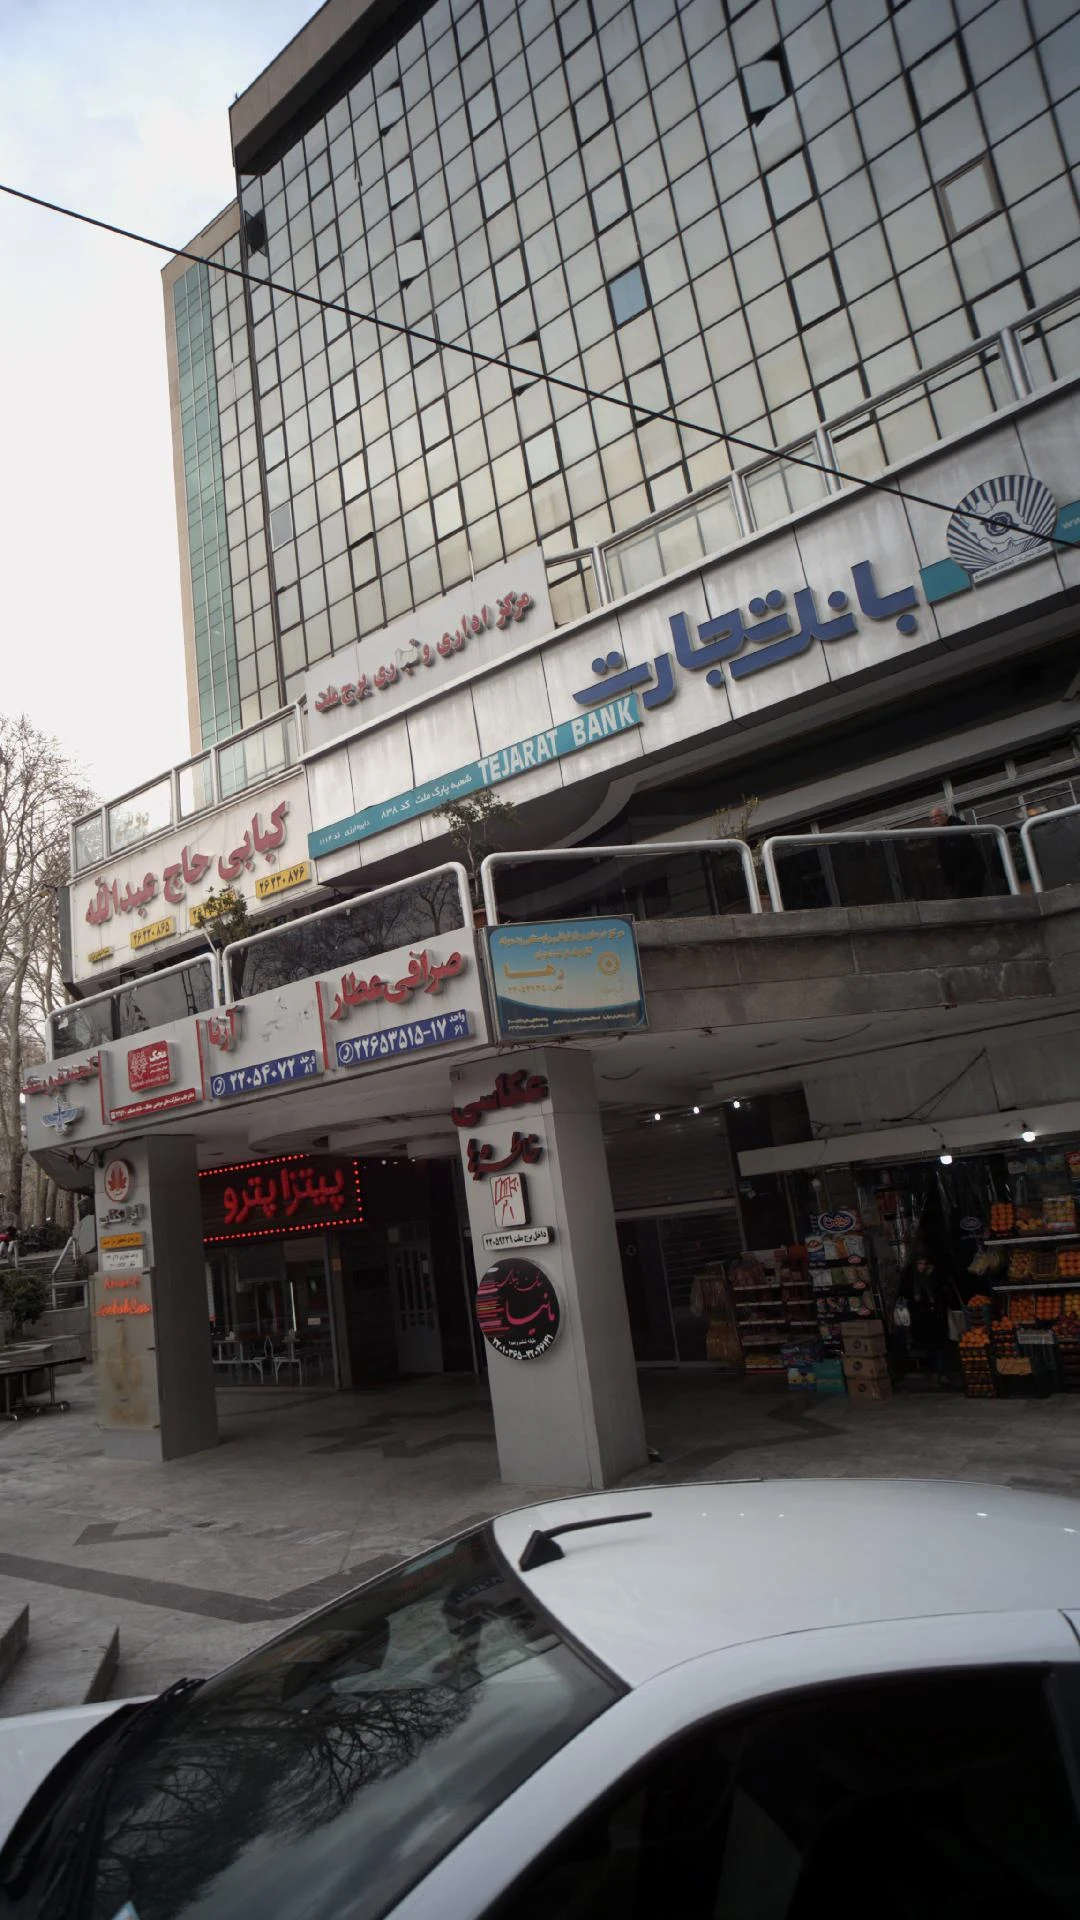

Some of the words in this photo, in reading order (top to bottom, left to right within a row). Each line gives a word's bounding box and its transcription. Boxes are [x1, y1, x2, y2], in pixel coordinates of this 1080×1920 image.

[496, 590, 531, 629] مرکز
[728, 560, 918, 682] بانک
[436, 605, 489, 656] اداری
[423, 644, 433, 666] و
[572, 589, 793, 711] تجارت
[315, 685, 340, 712] ملت
[341, 673, 371, 705] برج
[477, 729, 558, 785] TEJARAT
[571, 697, 635, 745] BANK
[415, 792, 431, 805] ملت
[432, 785, 450, 798] پارک
[451, 774, 473, 790] شعبه
[381, 806, 399, 820] ۸۳۸
[400, 799, 411, 811] کد
[218, 800, 288, 881] کبابی
[163, 846, 210, 904] حاج
[85, 872, 158, 925] عبدالله
[384, 950, 463, 1004] صرافی
[330, 971, 384, 1020] عطار
[449, 1012, 466, 1024] واحد
[453, 1024, 463, 1035] ۶۱
[149, 1050, 168, 1062] محک
[229, 1058, 296, 1092] ۲۲۰۵۴۰۷۲
[451, 1069, 548, 1127] عکاسی
[224, 1176, 277, 1224] پترو
[280, 1167, 345, 1216] پیتزا
[514, 1235, 524, 1243] ملت
[524, 1233, 534, 1243] برج
[533, 1230, 547, 1241] داخل
[505, 1292, 556, 1335] مانیا
